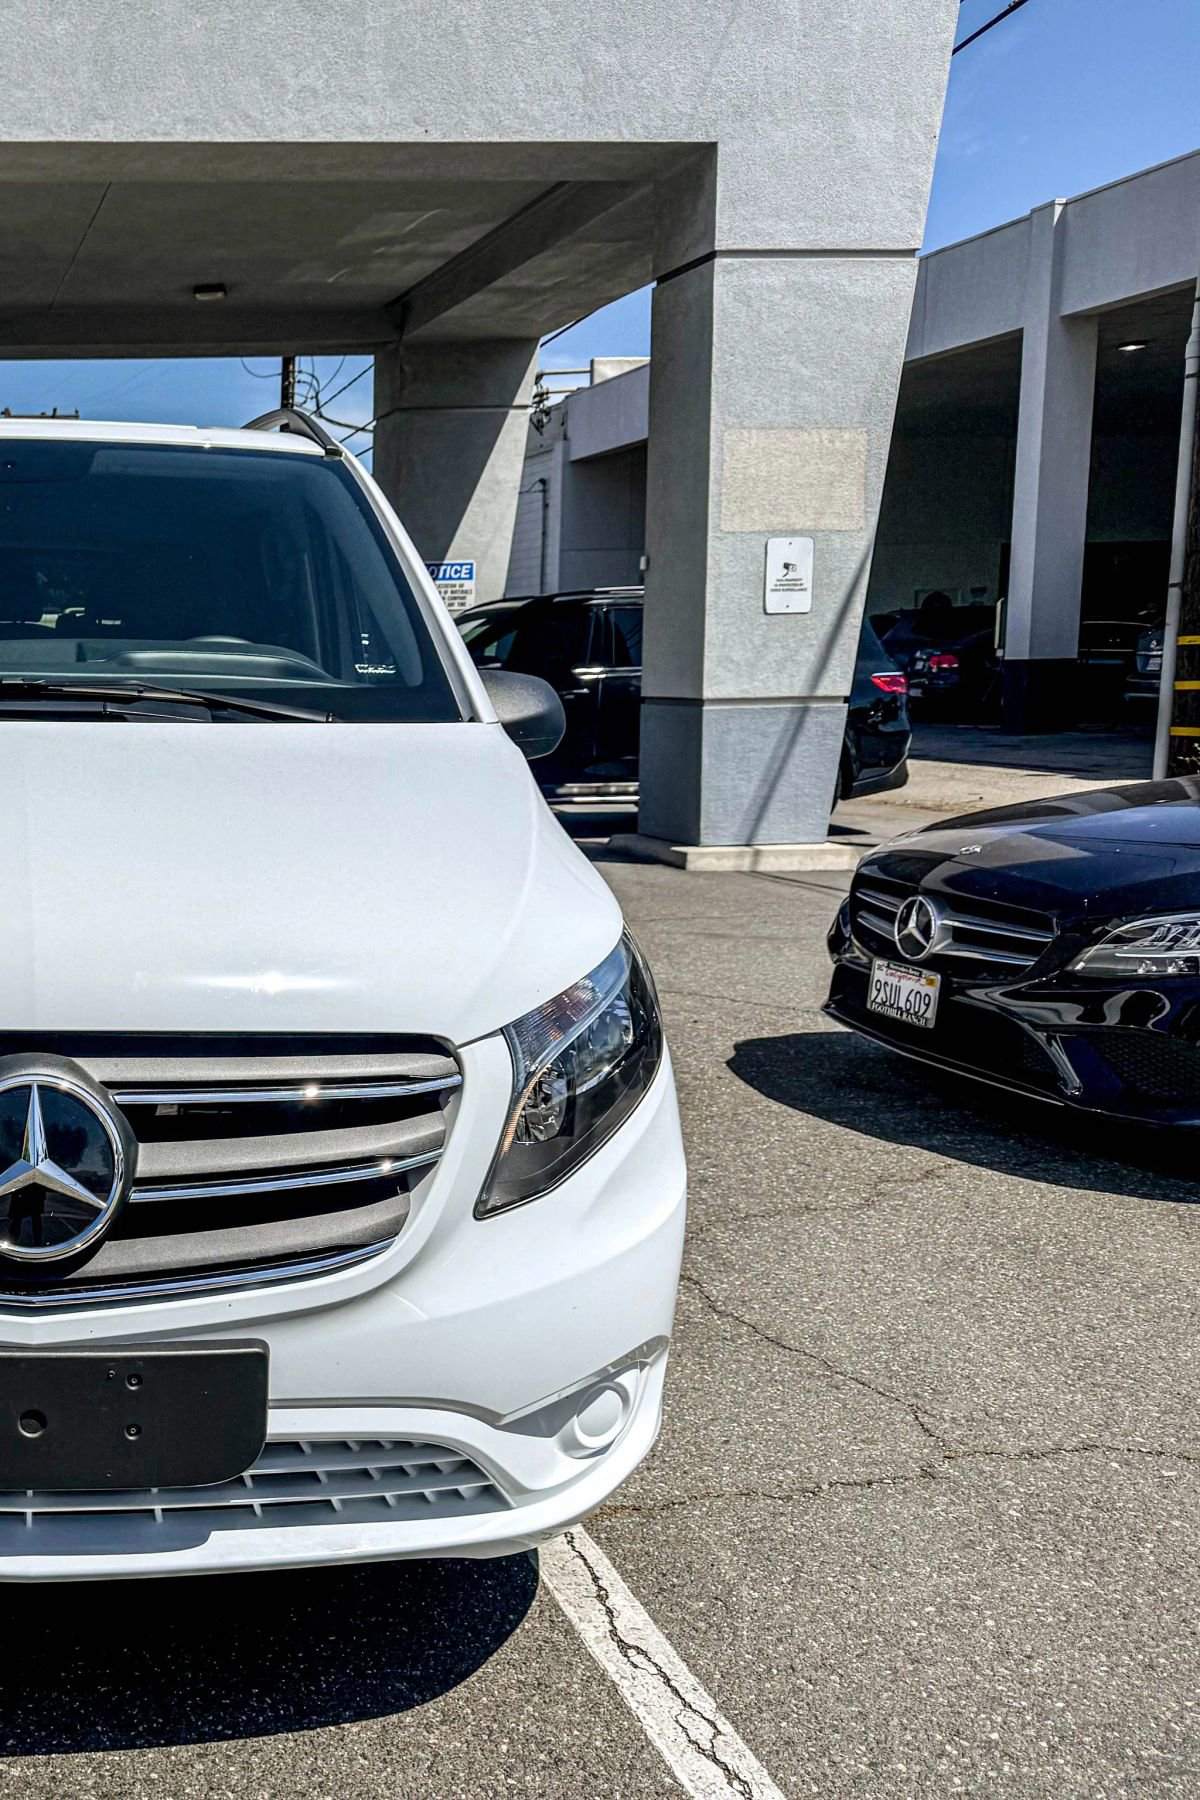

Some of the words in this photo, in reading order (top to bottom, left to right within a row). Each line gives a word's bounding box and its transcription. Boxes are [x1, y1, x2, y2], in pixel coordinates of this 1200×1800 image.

[427, 565, 471, 579] OTICE
[871, 979, 932, 1018] 9SUL609
[902, 1011, 927, 1026] RANCH
